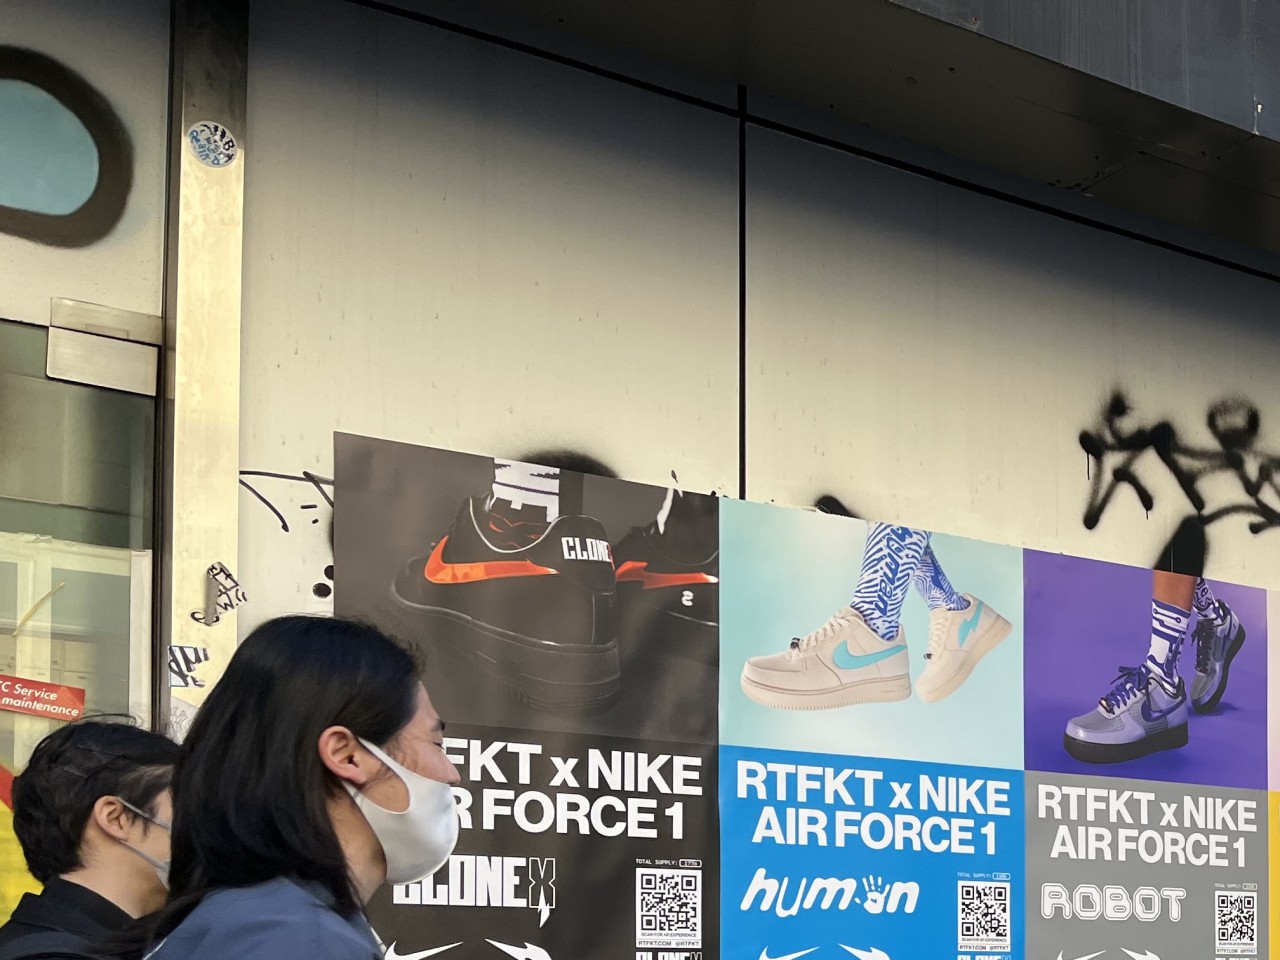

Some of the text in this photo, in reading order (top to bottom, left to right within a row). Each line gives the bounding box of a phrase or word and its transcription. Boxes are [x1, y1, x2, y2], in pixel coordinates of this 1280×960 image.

[2, 696, 79, 717] maintenance
[13, 683, 58, 701] Service
[549, 756, 580, 788] x
[588, 748, 703, 796] NIKE
[737, 760, 1011, 816] RTFKT x NIKE
[482, 788, 658, 839] FORCE
[664, 801, 684, 840] 1
[752, 806, 996, 855] AIR FORCE 1
[1037, 784, 1257, 832] RTFKT x NIKE
[1050, 824, 1246, 868] AIR FORCE 1
[1041, 883, 1187, 922] ROBOT
